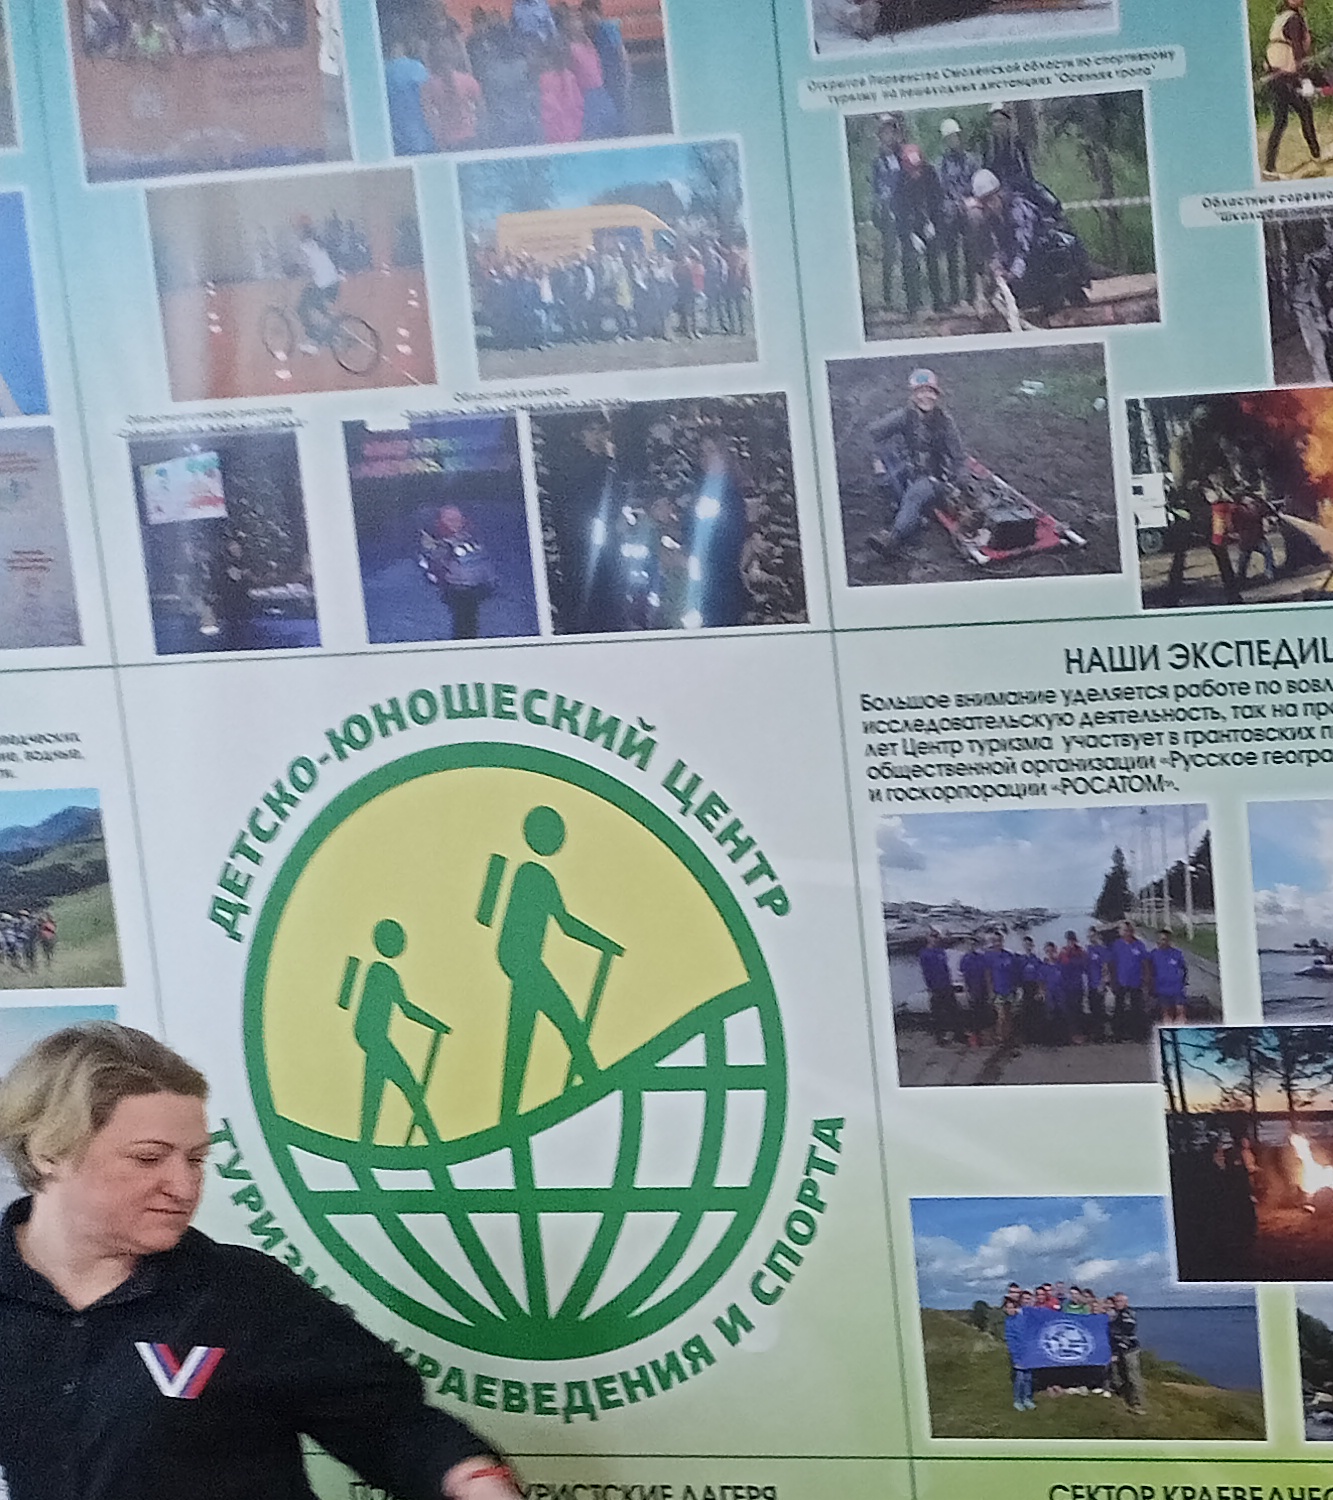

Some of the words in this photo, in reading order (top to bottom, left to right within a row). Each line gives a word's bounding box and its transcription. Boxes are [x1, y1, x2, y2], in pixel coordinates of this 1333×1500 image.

[1065, 643, 1160, 674] НАШИ
[860, 692, 951, 712] Большое
[955, 687, 1056, 706] внимание
[1060, 683, 1169, 707] уделяется
[1174, 678, 1250, 700] работе
[1255, 678, 1281, 695] по
[863, 713, 1075, 735] исследовательскую
[1079, 706, 1226, 729] деятельность,
[1231, 704, 1266, 720] так
[1271, 703, 1298, 718] на
[865, 744, 898, 758] лет
[902, 737, 964, 759] Центр
[968, 735, 1053, 757] туризма
[1061, 730, 1164, 753] участвует
[1169, 731, 1180, 745] в
[1184, 725, 1316, 749] грантовских
[867, 757, 1017, 781] общественной
[1021, 753, 1156, 777] организации
[1160, 749, 1257, 769] «Русское
[868, 788, 882, 801] и
[886, 781, 1047, 803] госкорпорации
[206, 682, 658, 943] ДЕТСКО-ЮНОШЕСКИЙ
[659, 758, 791, 918] ЦЕНТР
[388, 1334, 718, 1425] РАЕВЕДЕНИЯ
[714, 1303, 755, 1350] И
[750, 1114, 848, 1308] СПОРТА
